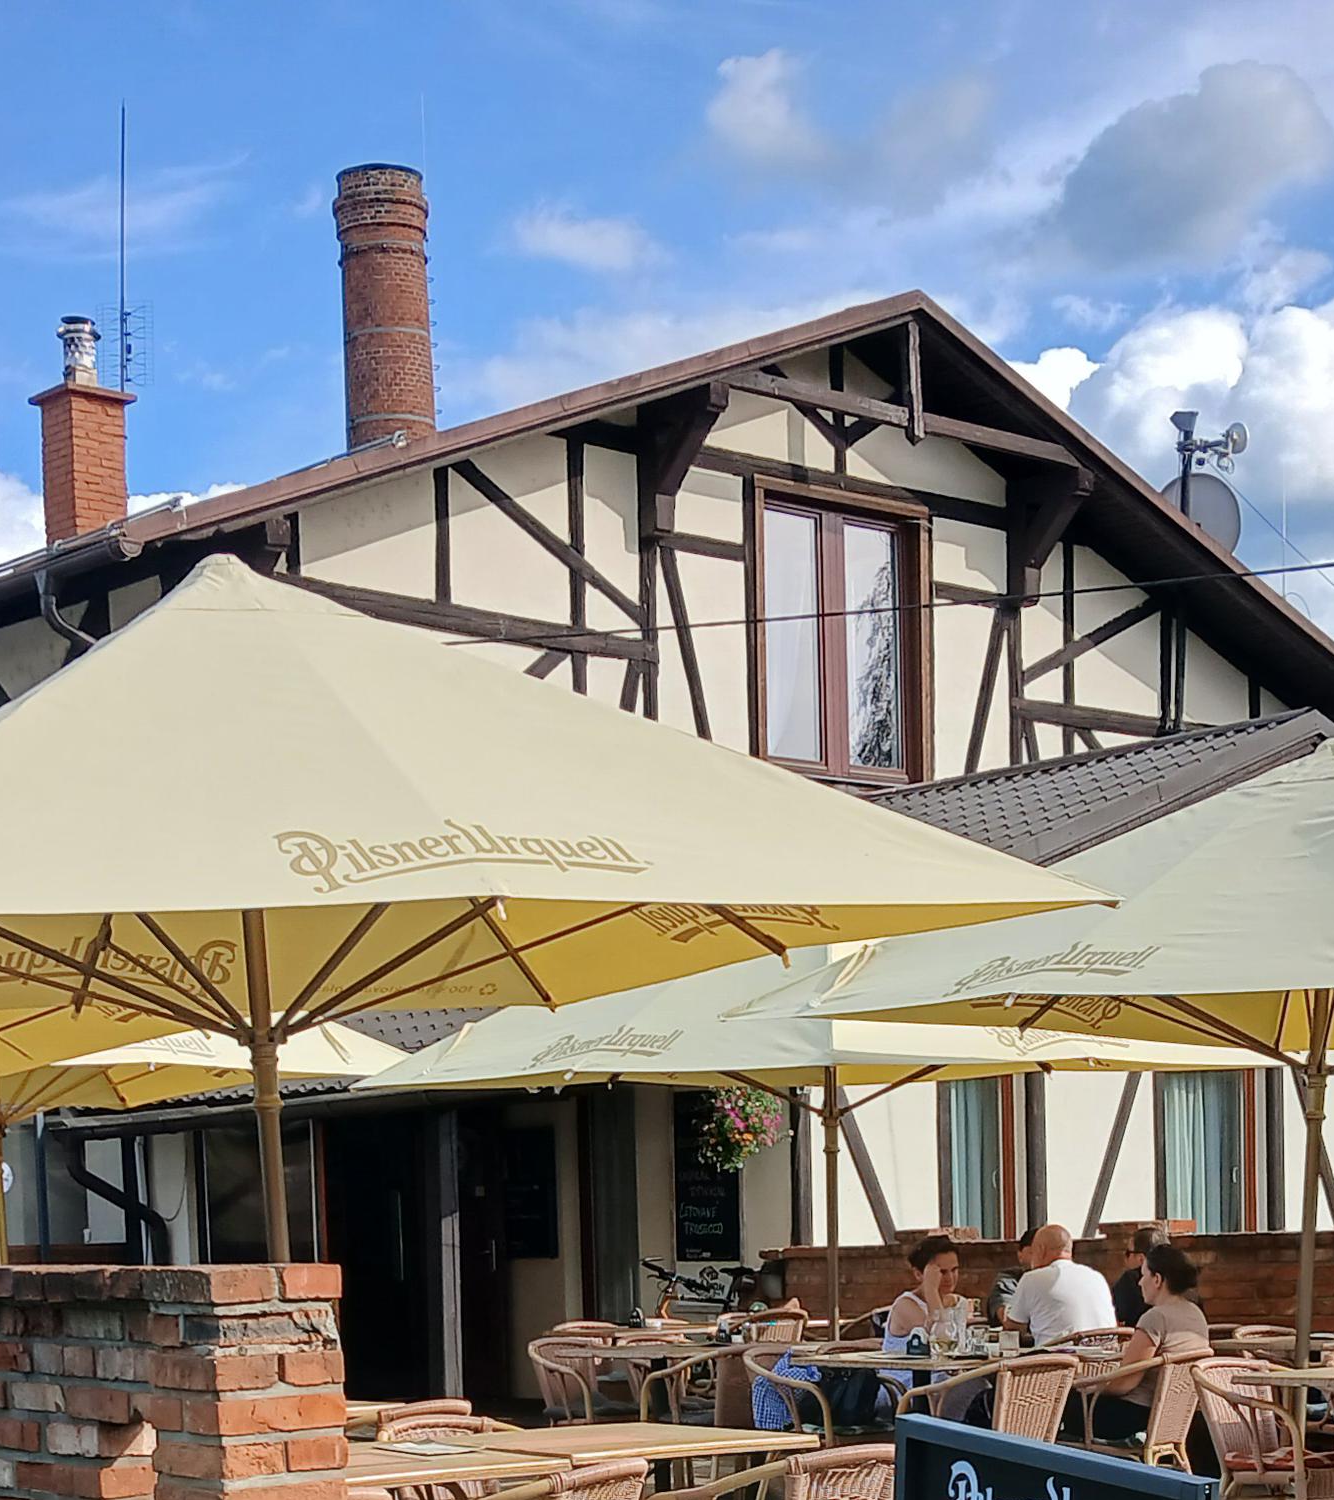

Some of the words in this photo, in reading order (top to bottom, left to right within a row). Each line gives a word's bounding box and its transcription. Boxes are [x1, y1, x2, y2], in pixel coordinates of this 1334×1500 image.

[271, 829, 463, 895] Pilsner
[444, 817, 643, 873] Urquell
[942, 951, 1065, 998] Pilsner
[1053, 940, 1161, 978] Urquell
[604, 1024, 685, 1058] Urquell
